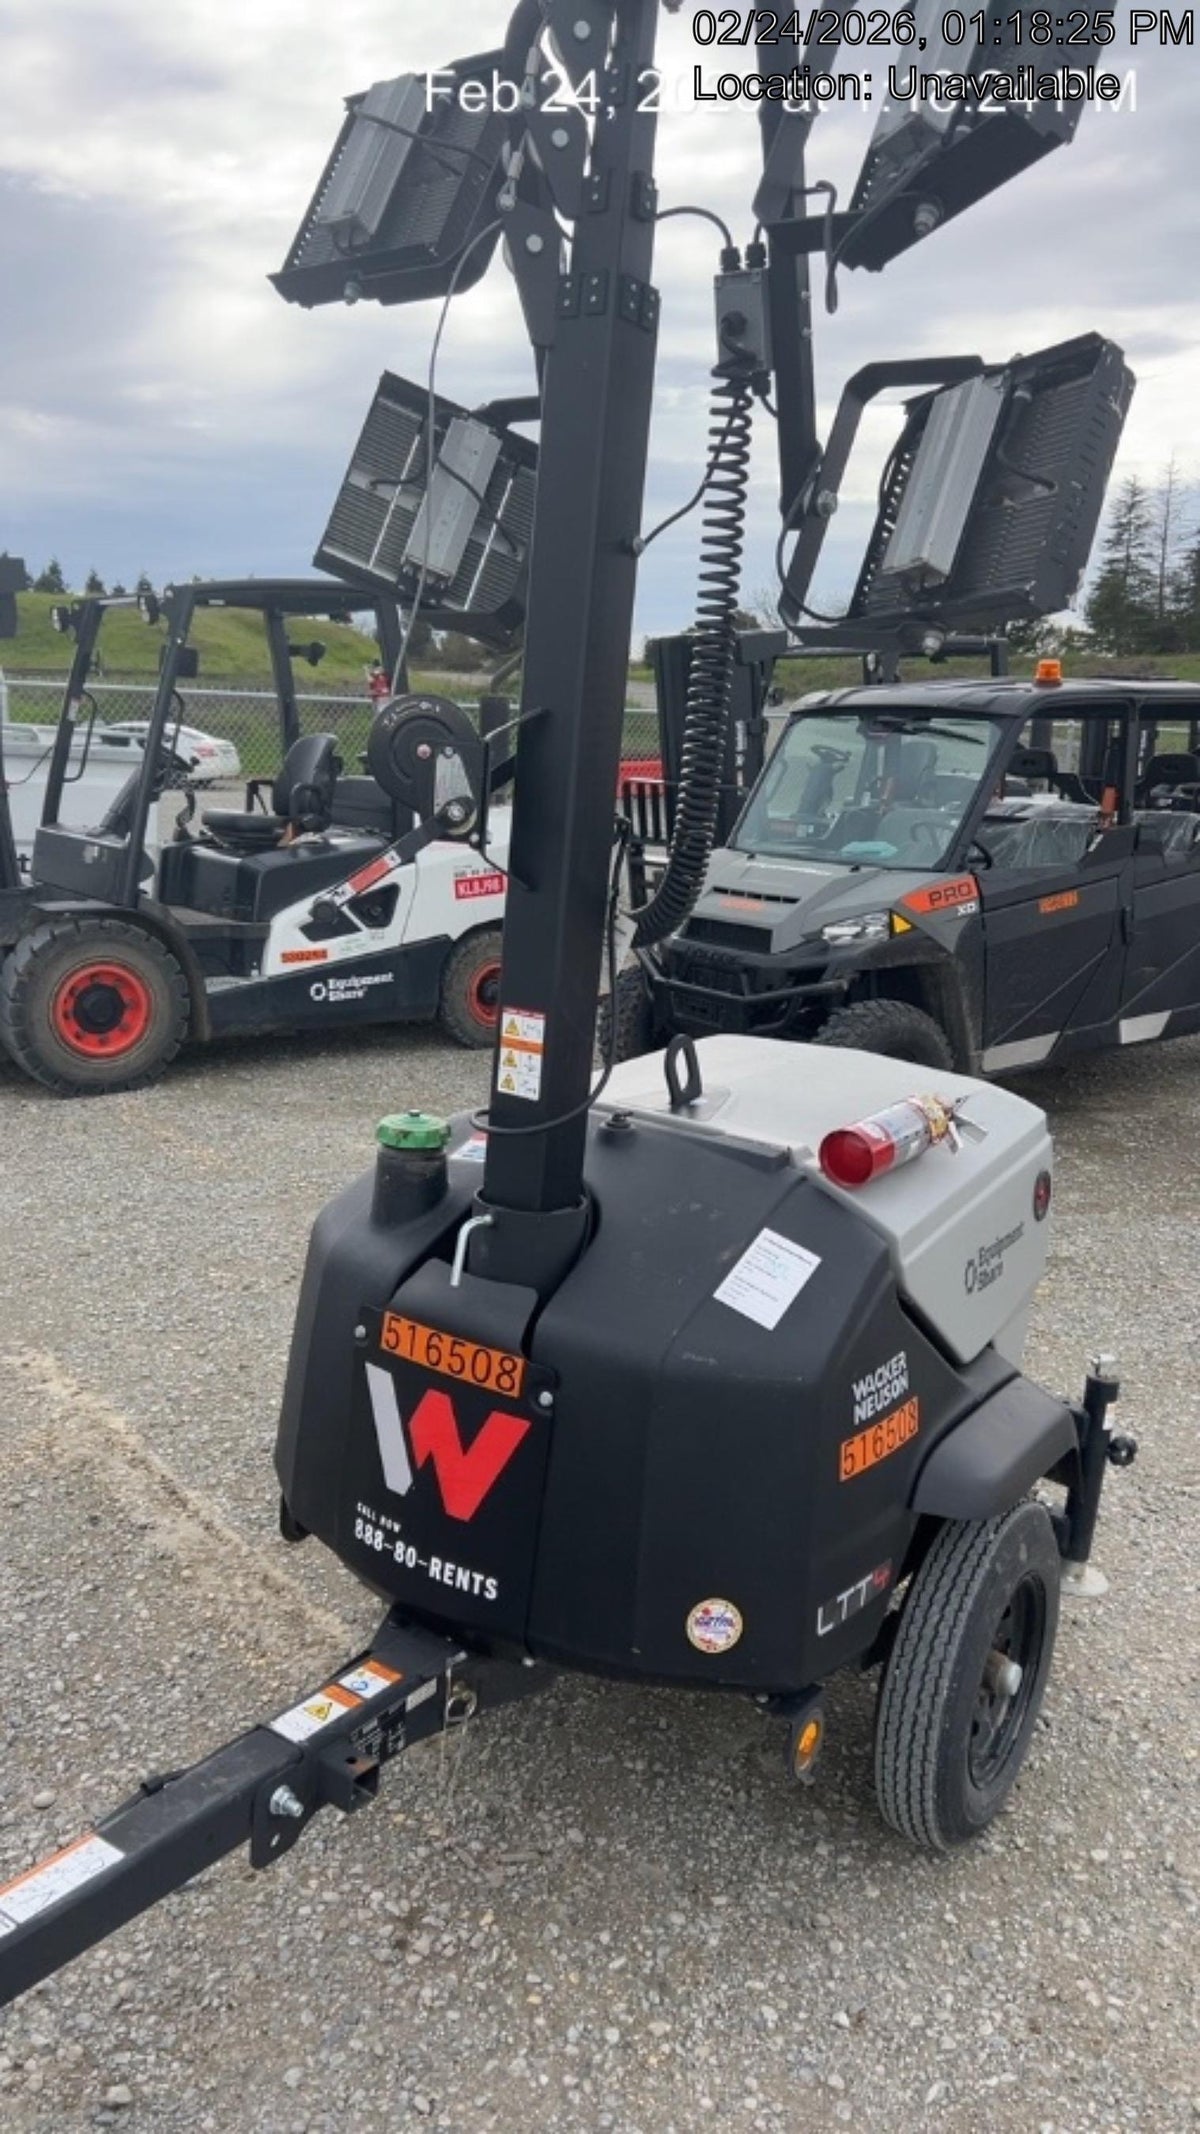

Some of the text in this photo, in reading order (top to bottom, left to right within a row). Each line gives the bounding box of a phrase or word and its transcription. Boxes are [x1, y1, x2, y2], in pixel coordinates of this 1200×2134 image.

[929, 883, 972, 906] PRO
[328, 972, 394, 990] Equipment
[979, 1221, 1024, 1267] Equipment
[977, 1261, 1003, 1292] Share
[385, 1315, 519, 1393] 516508
[851, 1350, 907, 1402] WACKER
[853, 1370, 909, 1426] NEUSON
[843, 1400, 917, 1475] 516508
[356, 1502, 402, 1533] CALL NOW
[355, 1518, 498, 1600] 888-80-RENTS
[816, 1560, 891, 1637] LTT4
